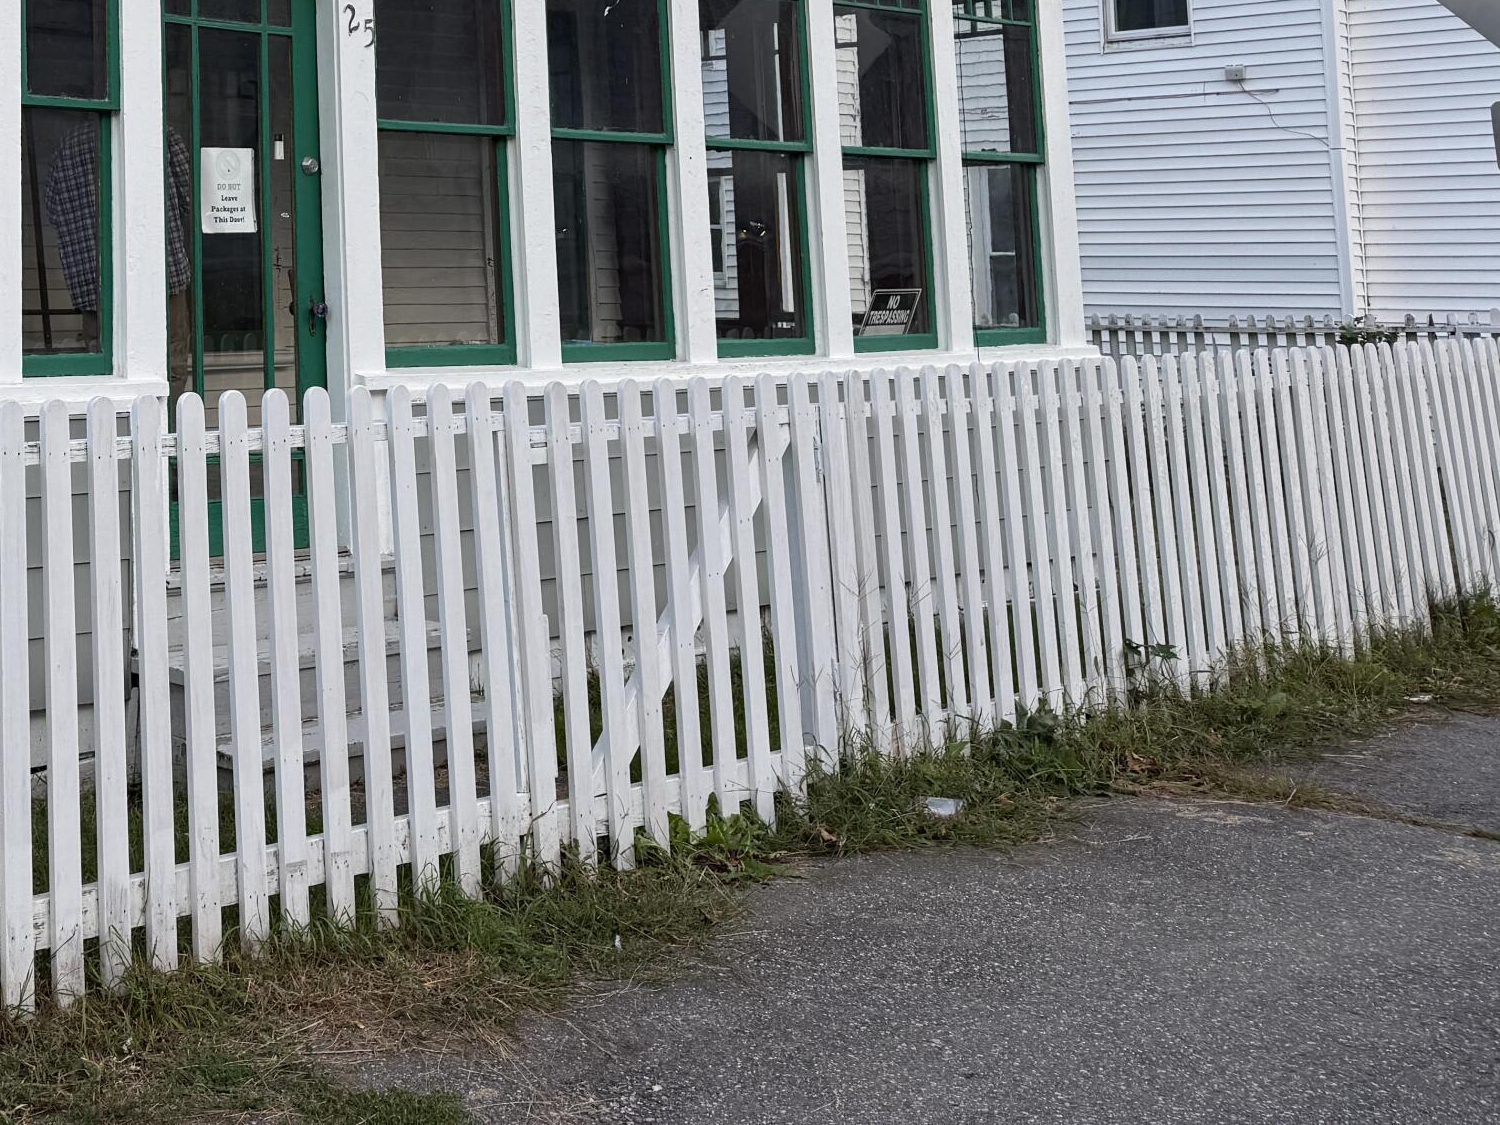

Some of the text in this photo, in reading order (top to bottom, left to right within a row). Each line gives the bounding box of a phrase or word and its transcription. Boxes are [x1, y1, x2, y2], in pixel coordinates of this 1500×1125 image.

[343, 3, 374, 48] 25
[887, 295, 901, 309] NO
[868, 310, 910, 324] TRESPASSING
